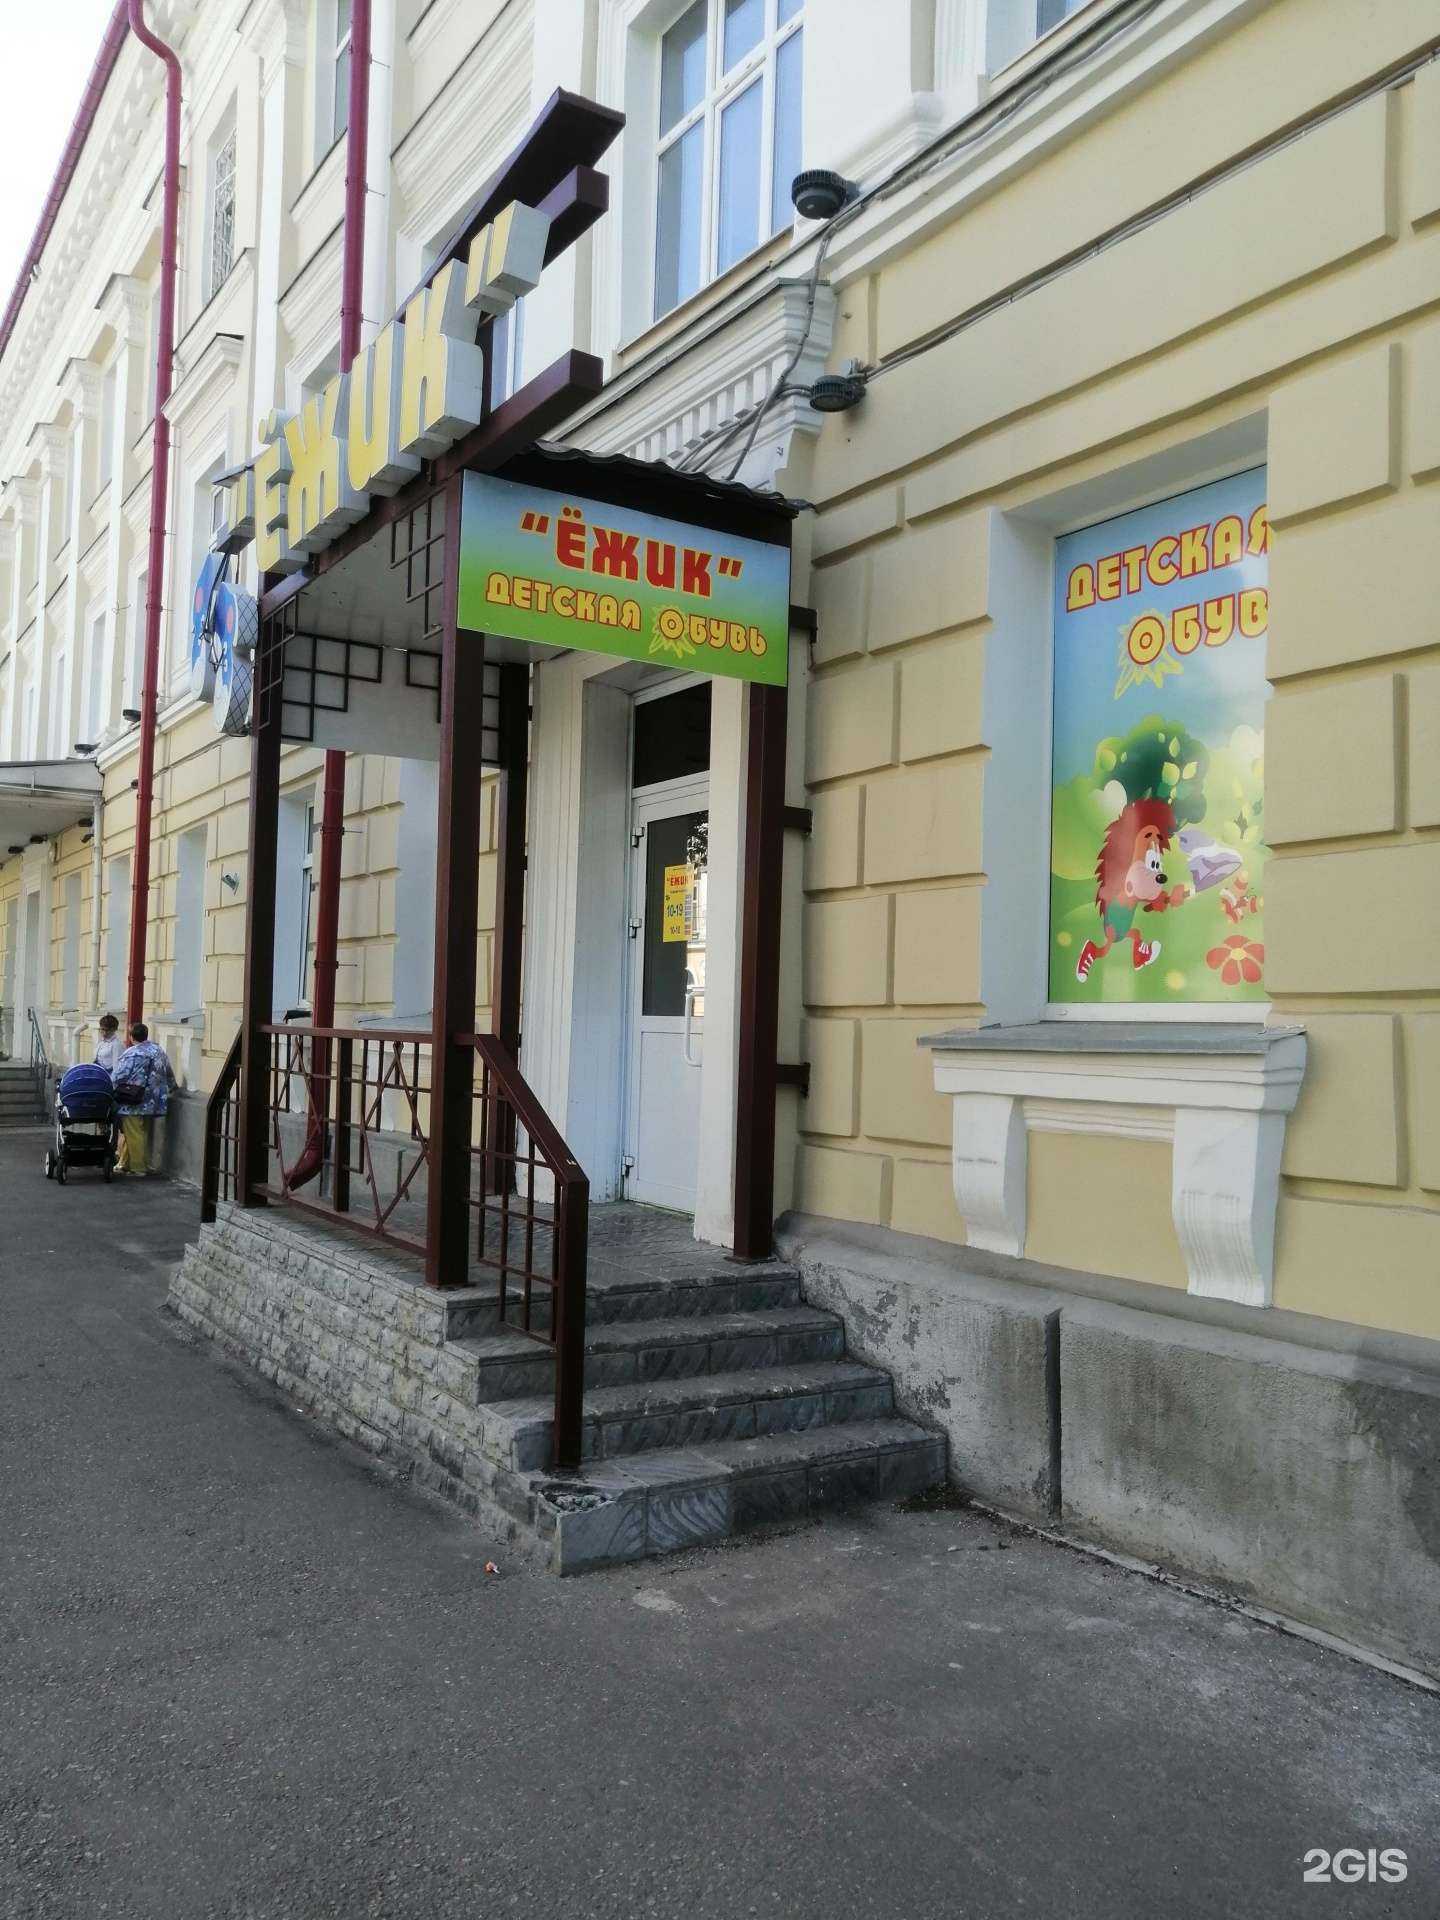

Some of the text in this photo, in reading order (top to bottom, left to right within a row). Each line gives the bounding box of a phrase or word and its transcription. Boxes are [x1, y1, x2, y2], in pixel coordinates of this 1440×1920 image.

[520, 506, 744, 599] "ЁЖИК"
[486, 572, 768, 657] ДЕТСКАЯ ОБУВЬ
[666, 903, 684, 918] 10-19
